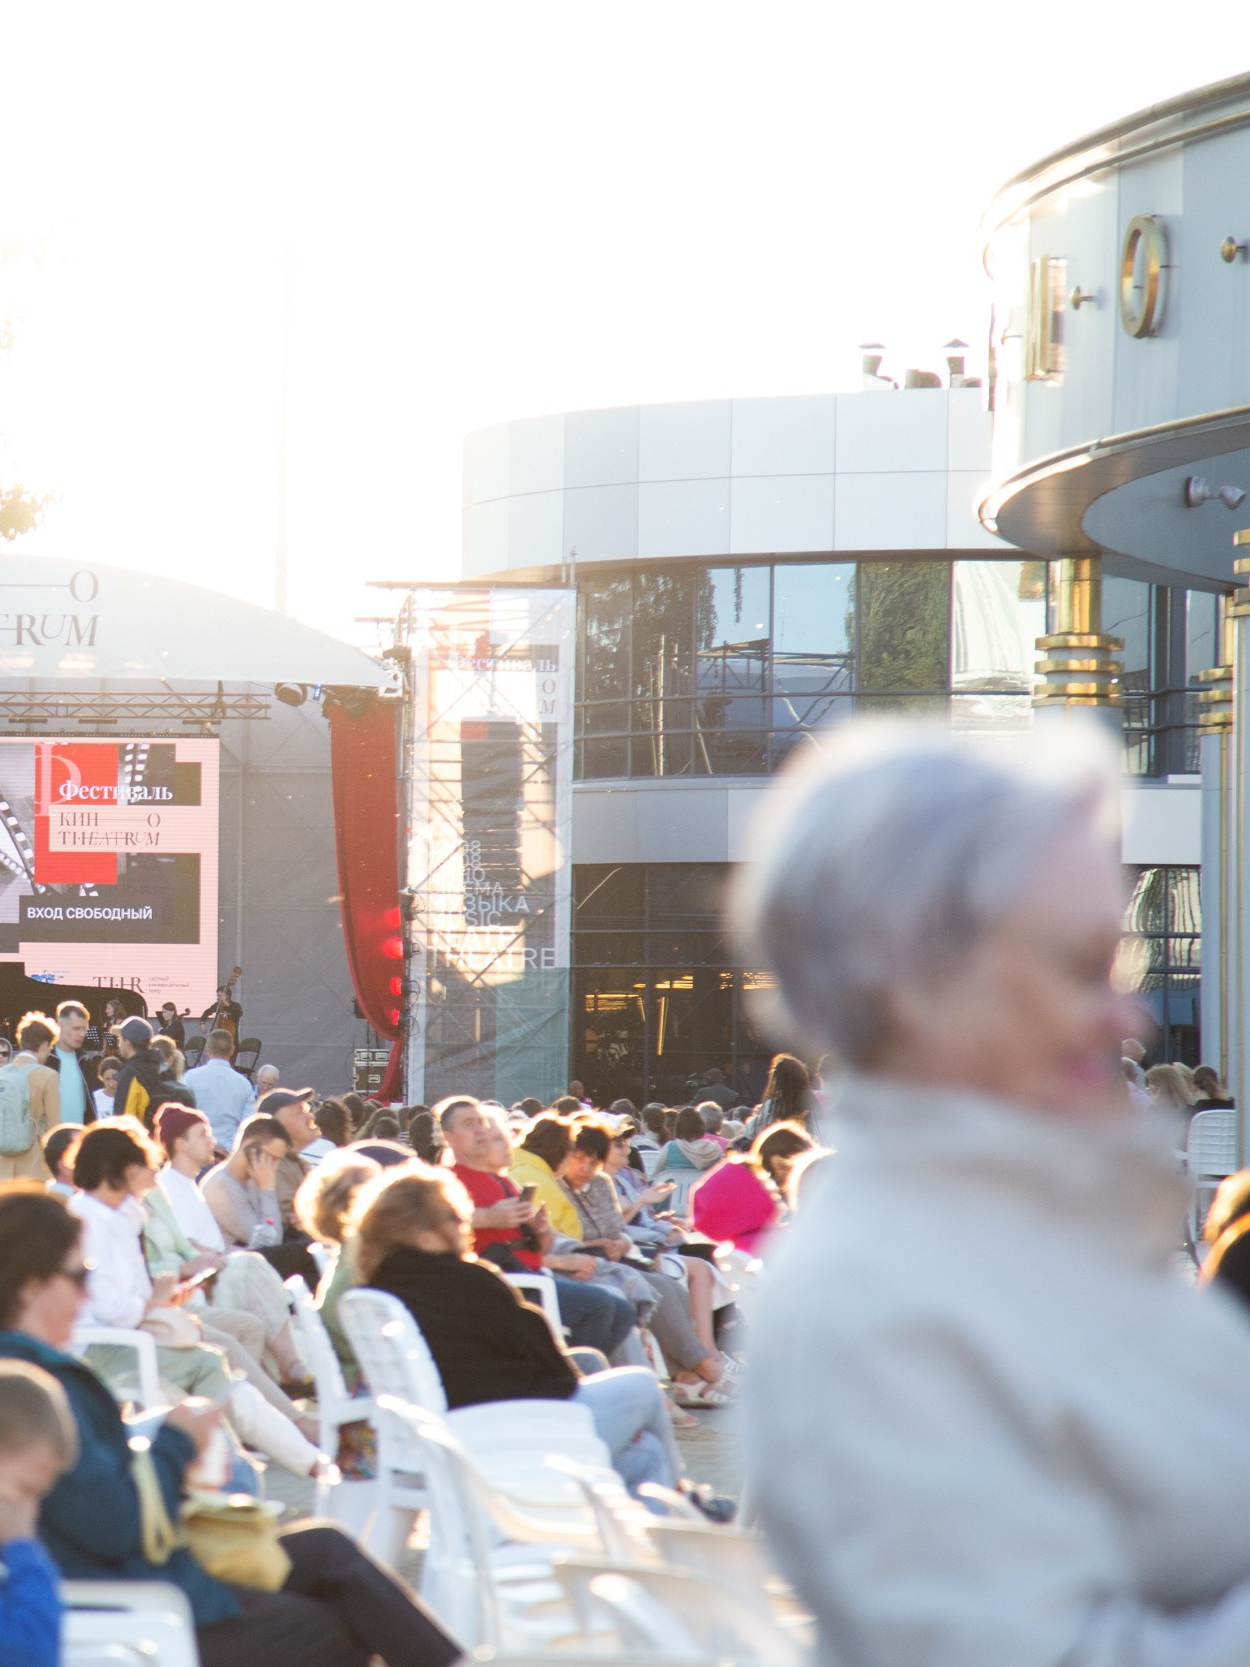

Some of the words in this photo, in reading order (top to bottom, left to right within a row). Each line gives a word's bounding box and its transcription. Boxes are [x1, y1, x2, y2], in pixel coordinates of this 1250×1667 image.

[59, 780, 174, 800] Фестиваль
[27, 907, 64, 920] ВХОД
[66, 905, 153, 920] СВОБОДНЫЙ
